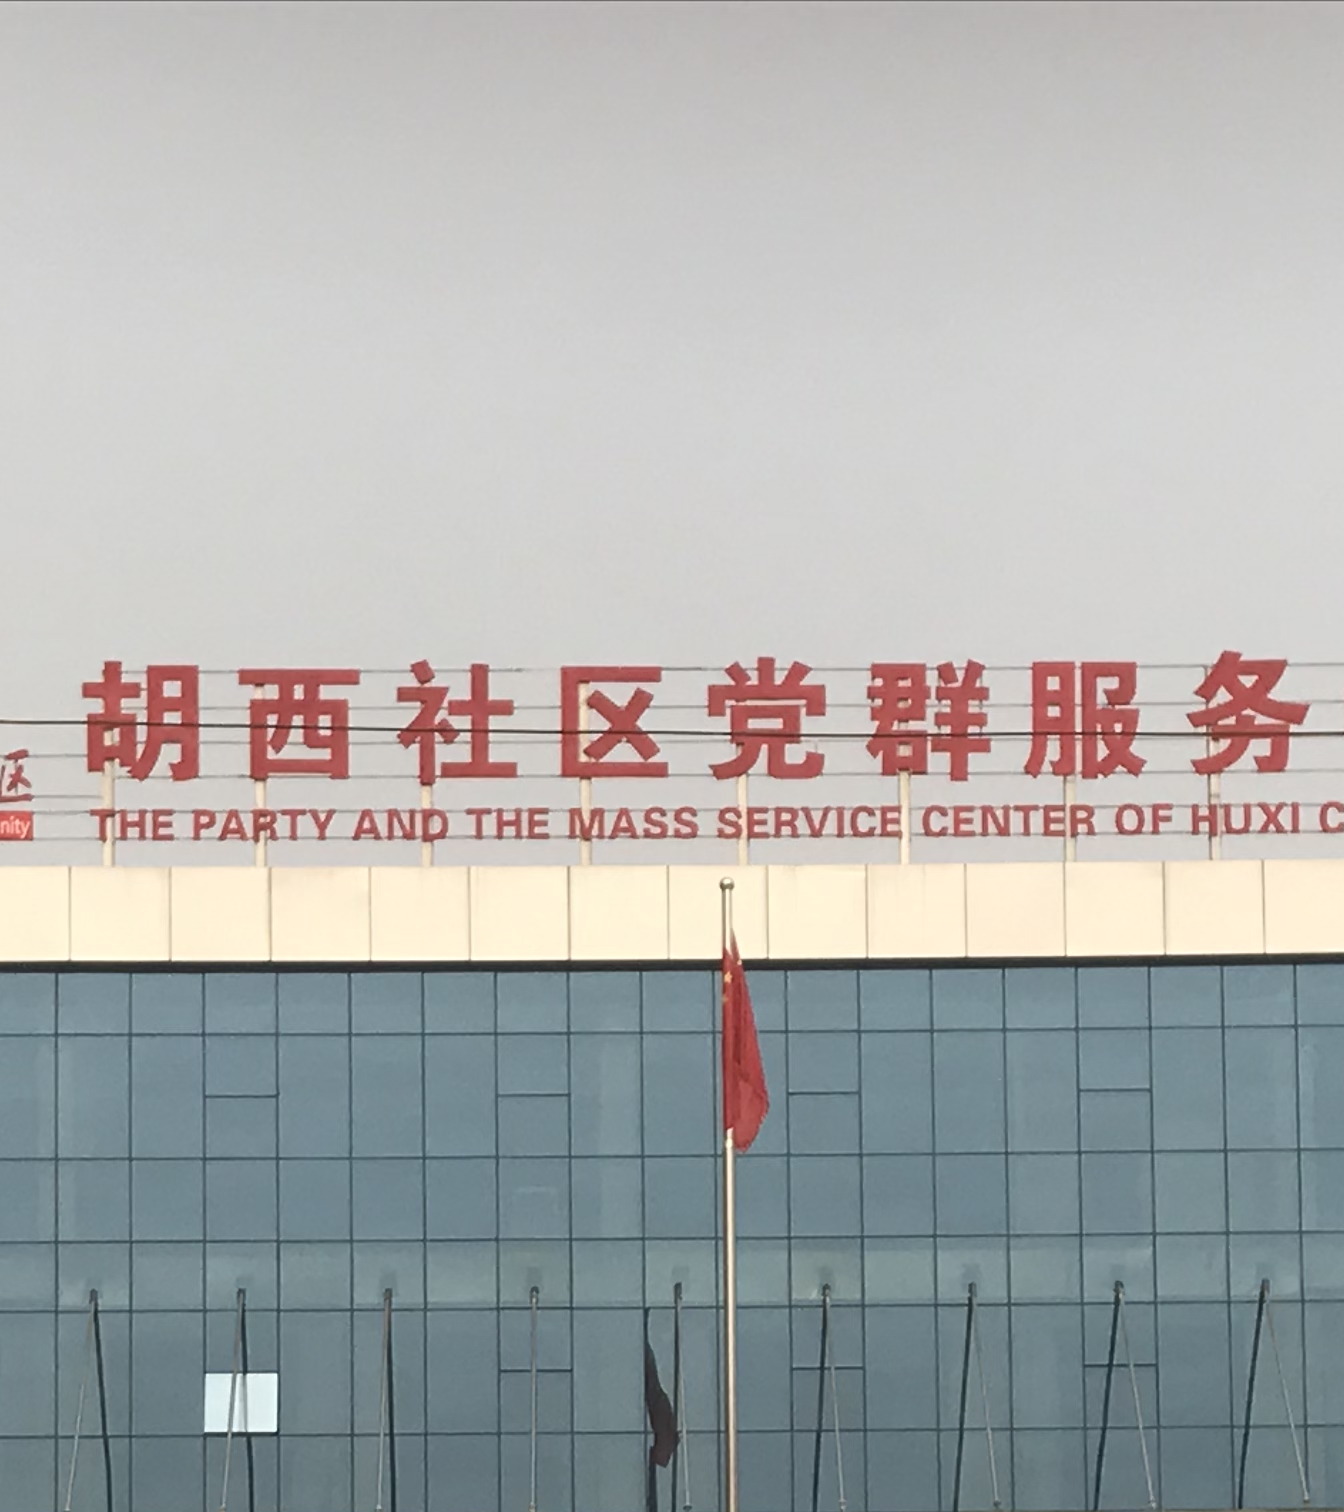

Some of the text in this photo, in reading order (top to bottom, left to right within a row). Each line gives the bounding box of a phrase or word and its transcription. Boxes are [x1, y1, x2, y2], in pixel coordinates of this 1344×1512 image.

[90, 808, 172, 841] THE
[192, 808, 333, 841] PARTY
[353, 807, 448, 843] AND
[467, 808, 547, 840] THE
[567, 807, 699, 841] MASS
[717, 806, 903, 840] SERVICE
[922, 804, 1094, 837] CENTER
[1115, 803, 1172, 835] OF
[1191, 803, 1300, 836] HUXI
